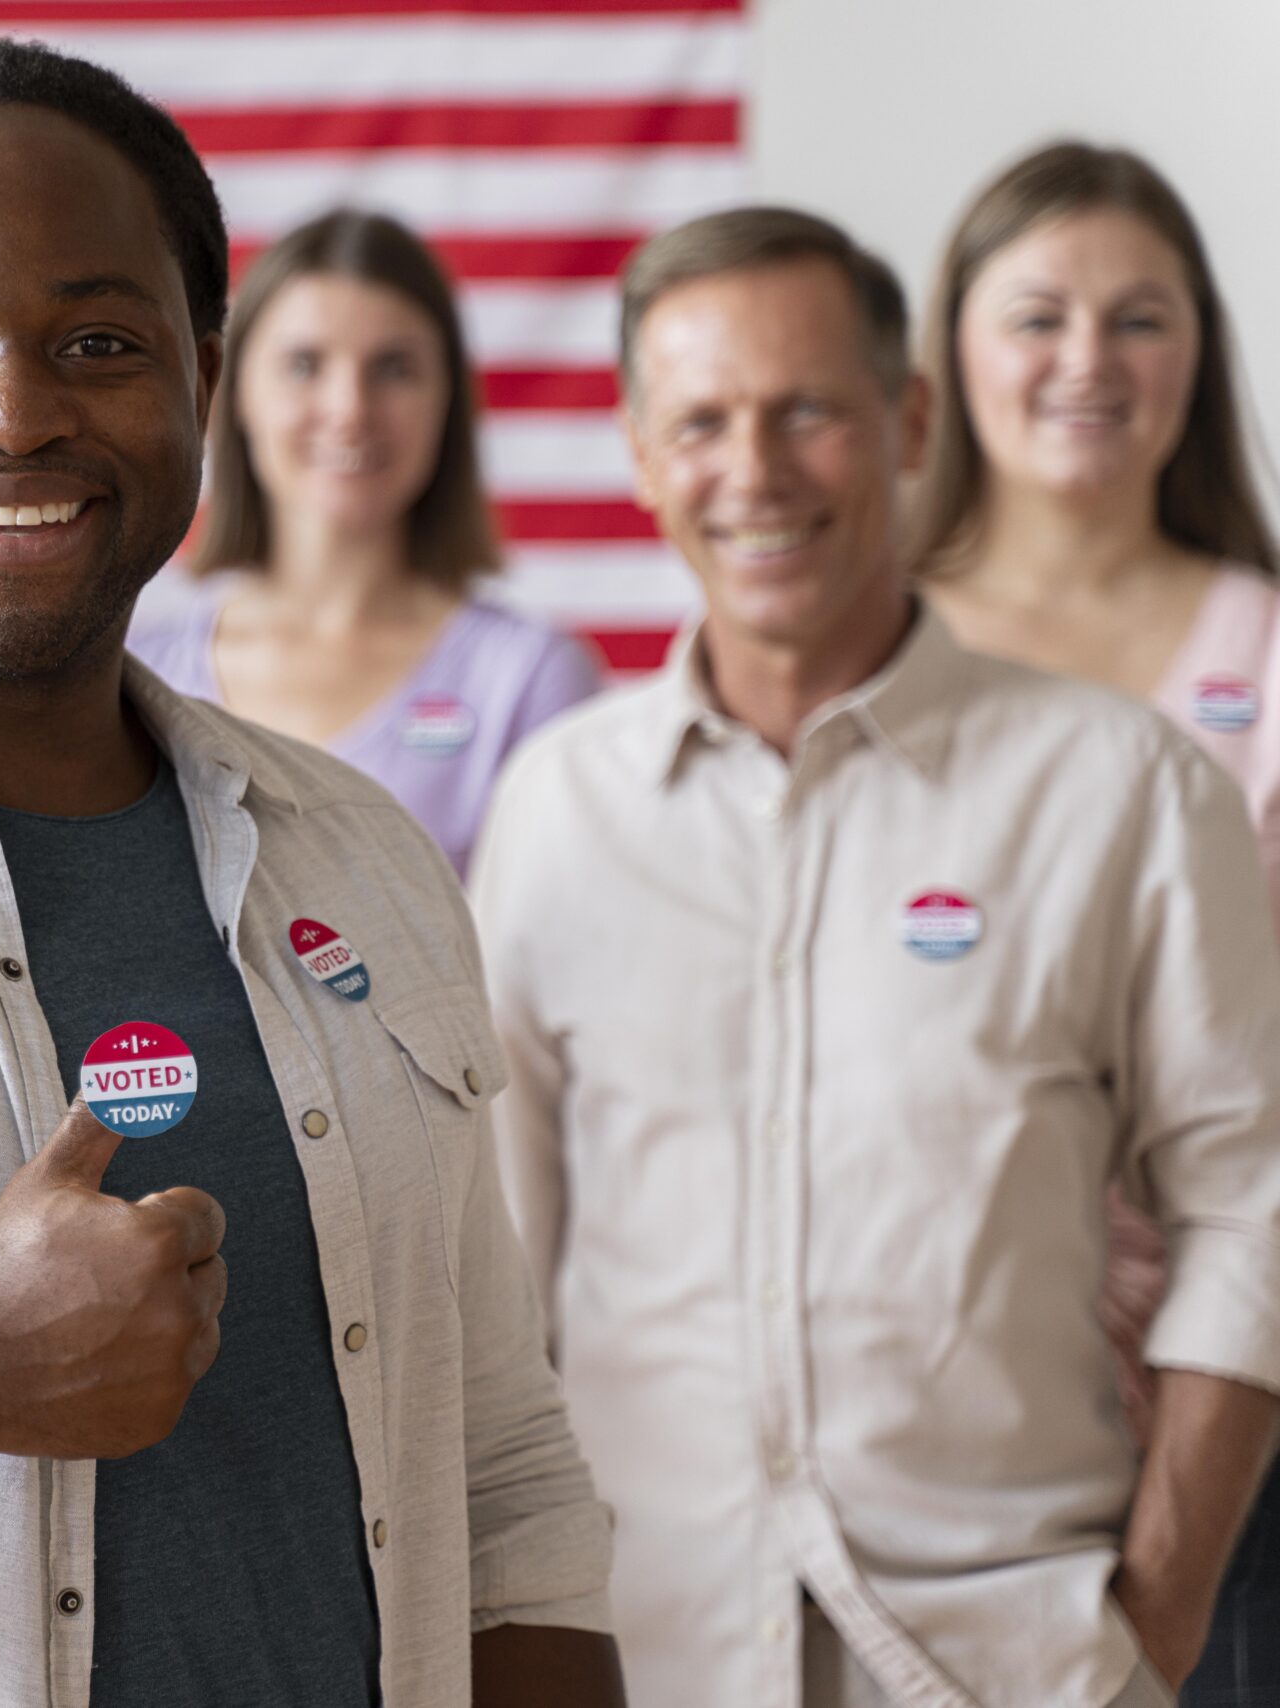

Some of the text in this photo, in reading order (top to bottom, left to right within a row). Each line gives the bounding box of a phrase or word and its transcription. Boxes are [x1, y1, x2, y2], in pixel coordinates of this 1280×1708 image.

[307, 946, 350, 974] VOTED
[131, 1034, 139, 1054] I
[94, 1065, 182, 1093] VOTED
[109, 1102, 175, 1124] TODAY
